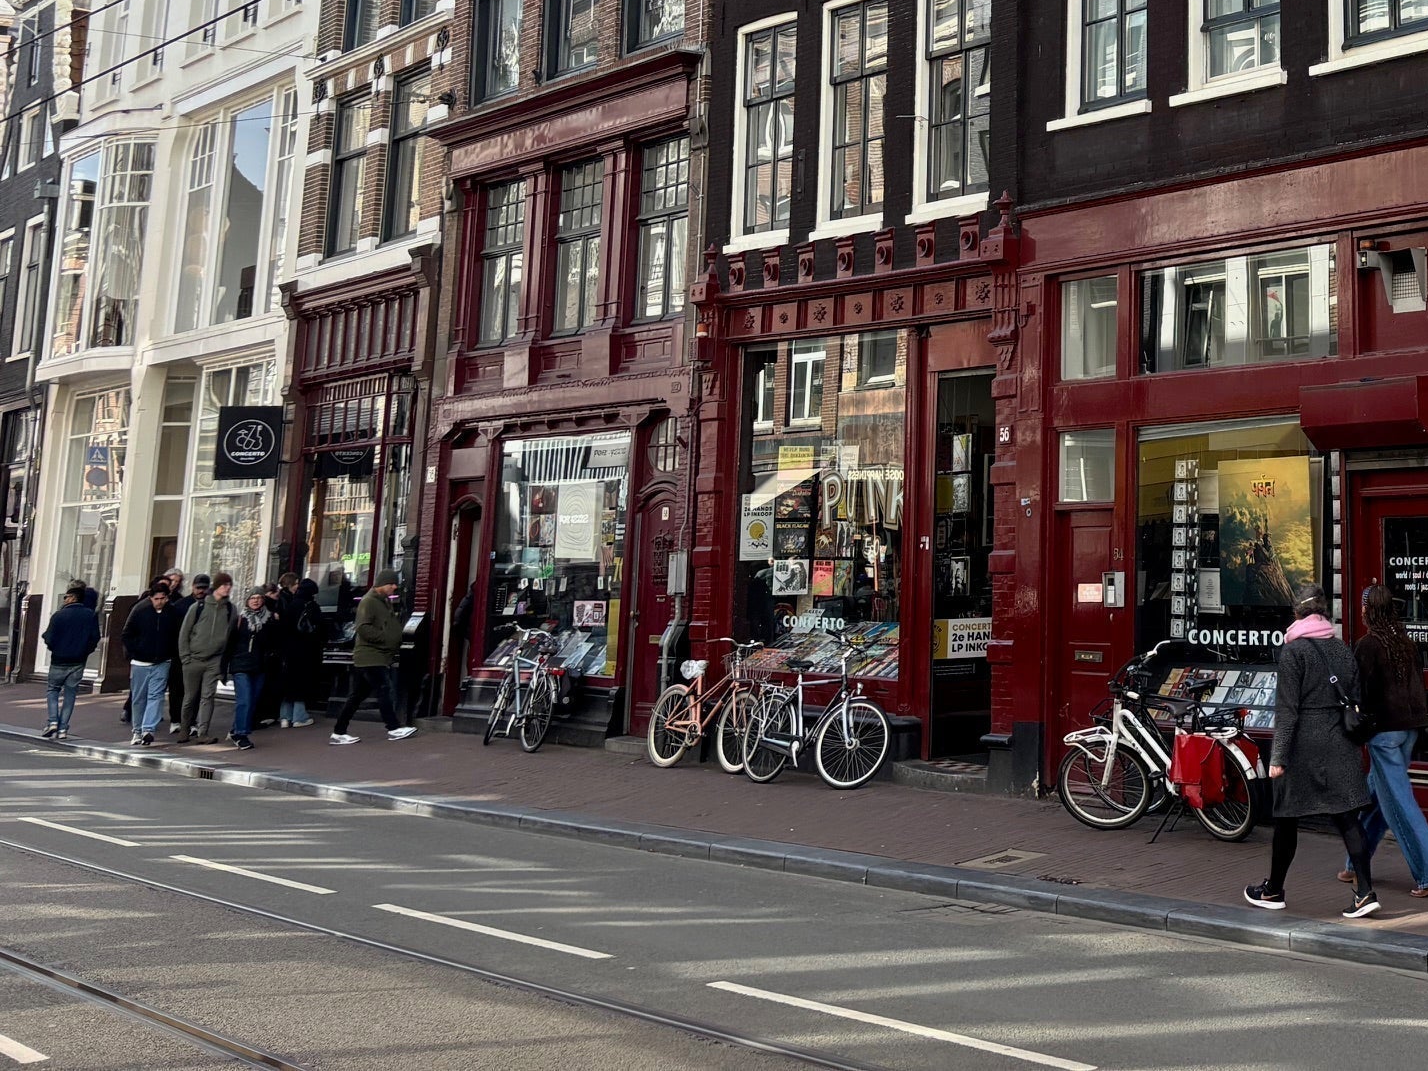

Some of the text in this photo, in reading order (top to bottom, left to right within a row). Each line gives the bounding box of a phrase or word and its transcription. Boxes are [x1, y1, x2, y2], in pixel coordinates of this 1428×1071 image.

[999, 427, 1010, 442] 56
[821, 461, 905, 531] PUNK
[1113, 547, 1124, 561] 54
[1395, 570, 1408, 579] world
[1412, 570, 1422, 579] soul
[1404, 583, 1416, 591] roots
[782, 615, 845, 630] CONCERTO
[952, 631, 993, 642] 2e HAN
[1188, 629, 1285, 646] CONCERTO
[951, 644, 964, 652] LP
